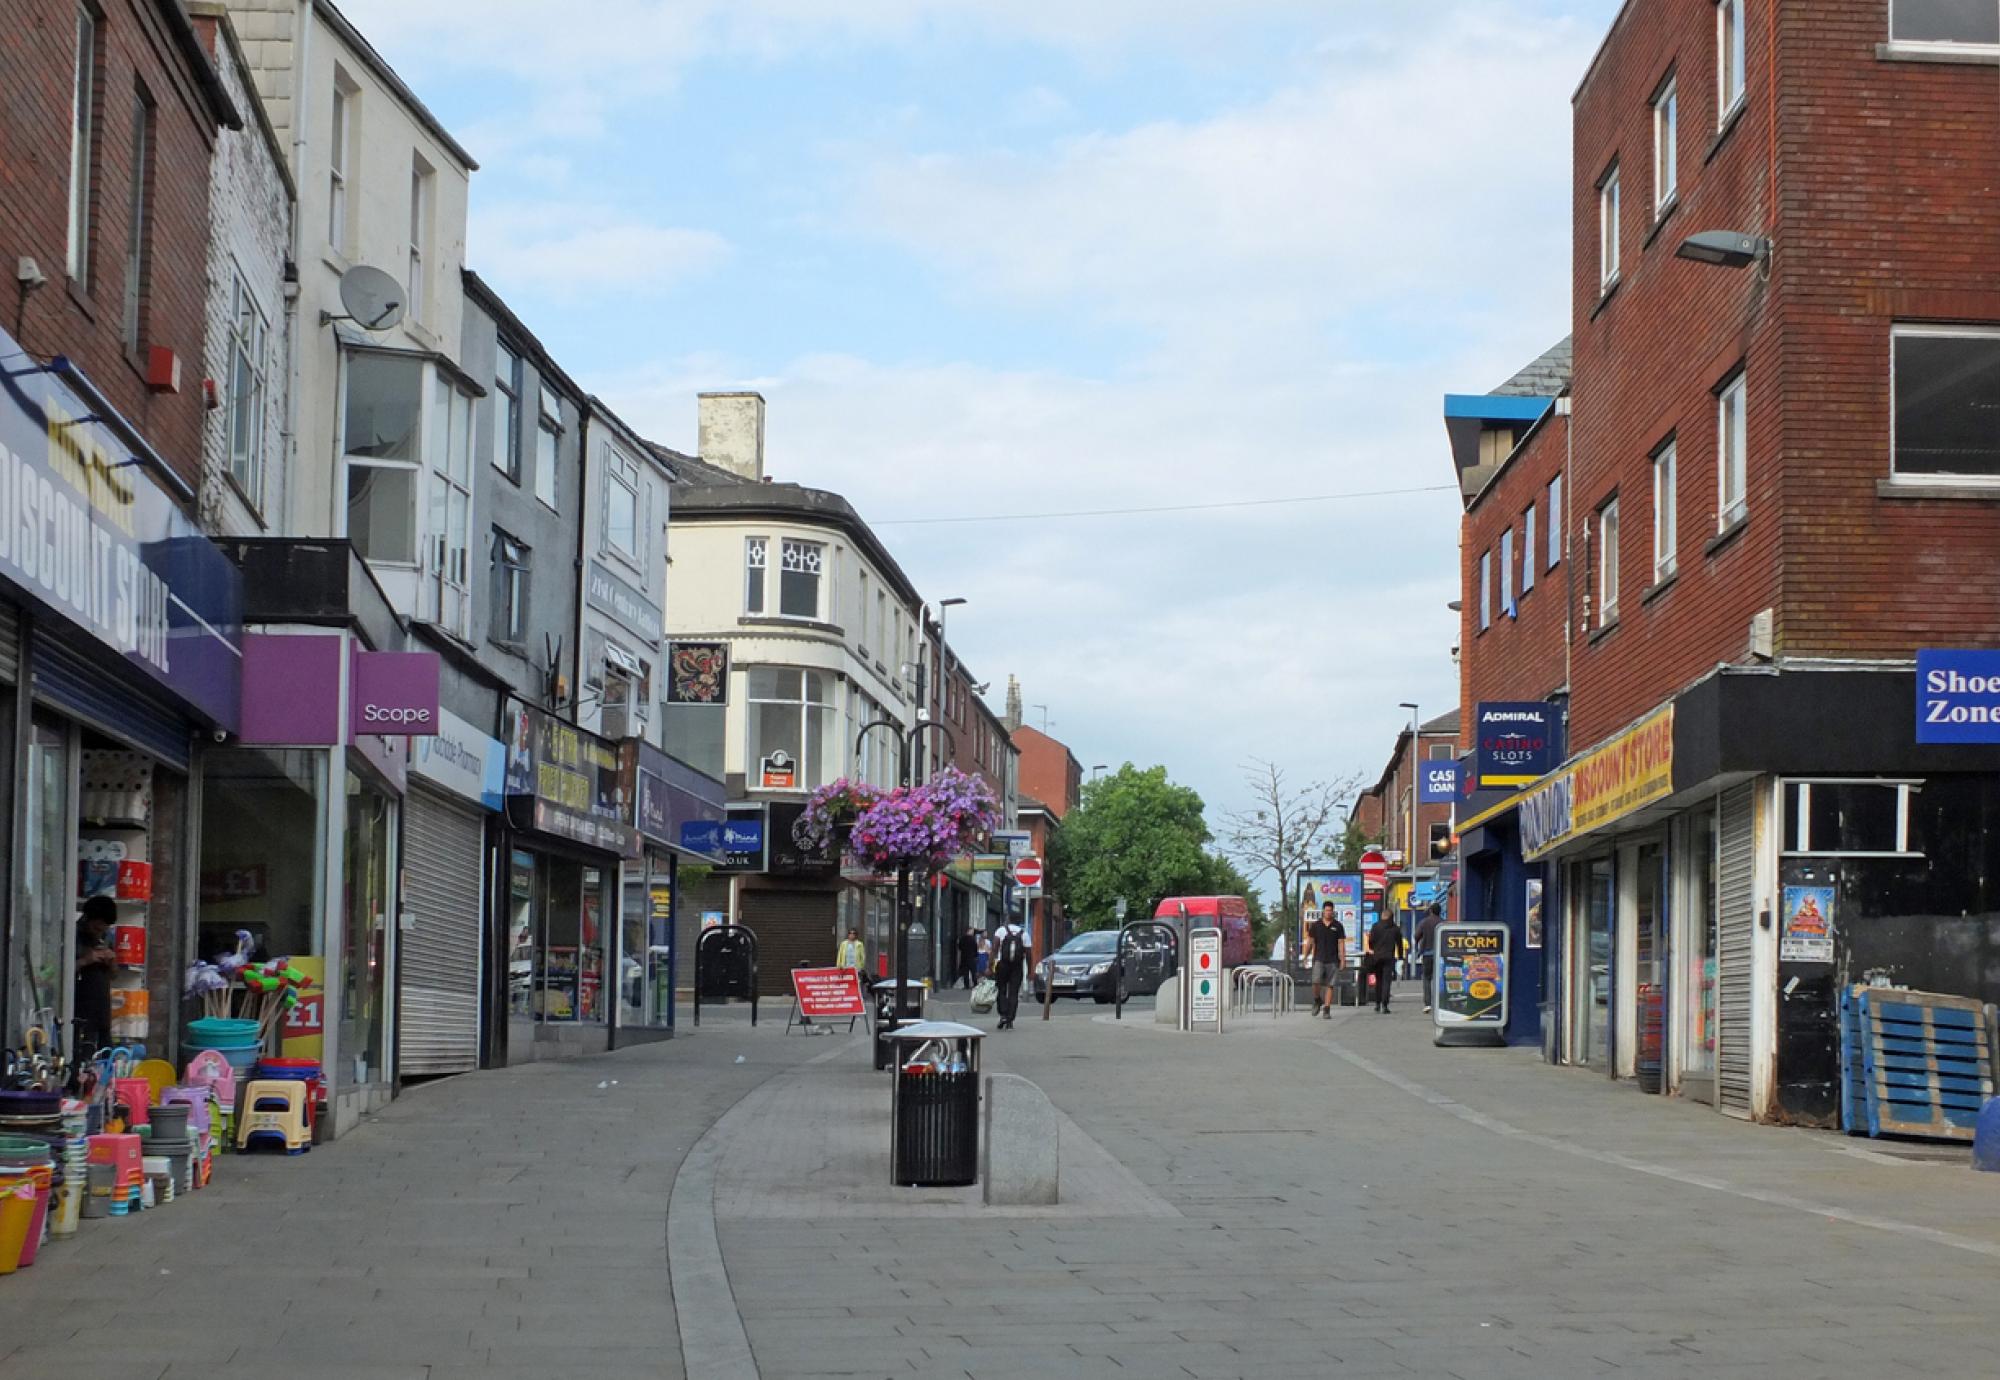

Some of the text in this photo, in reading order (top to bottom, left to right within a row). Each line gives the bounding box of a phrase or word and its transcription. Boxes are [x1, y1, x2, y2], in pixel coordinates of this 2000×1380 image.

[115, 543, 170, 674] STORE
[1926, 670, 2000, 694] Shoe
[364, 703, 431, 725] Scope
[1482, 711, 1545, 723] ADMIRAL
[1925, 699, 2000, 723] Zone
[1483, 738, 1545, 749] CASINO
[1629, 717, 1670, 781] STORE
[1492, 750, 1534, 761] SLOTS
[1447, 936, 1498, 949] STORM
[286, 1001, 321, 1028] £1
